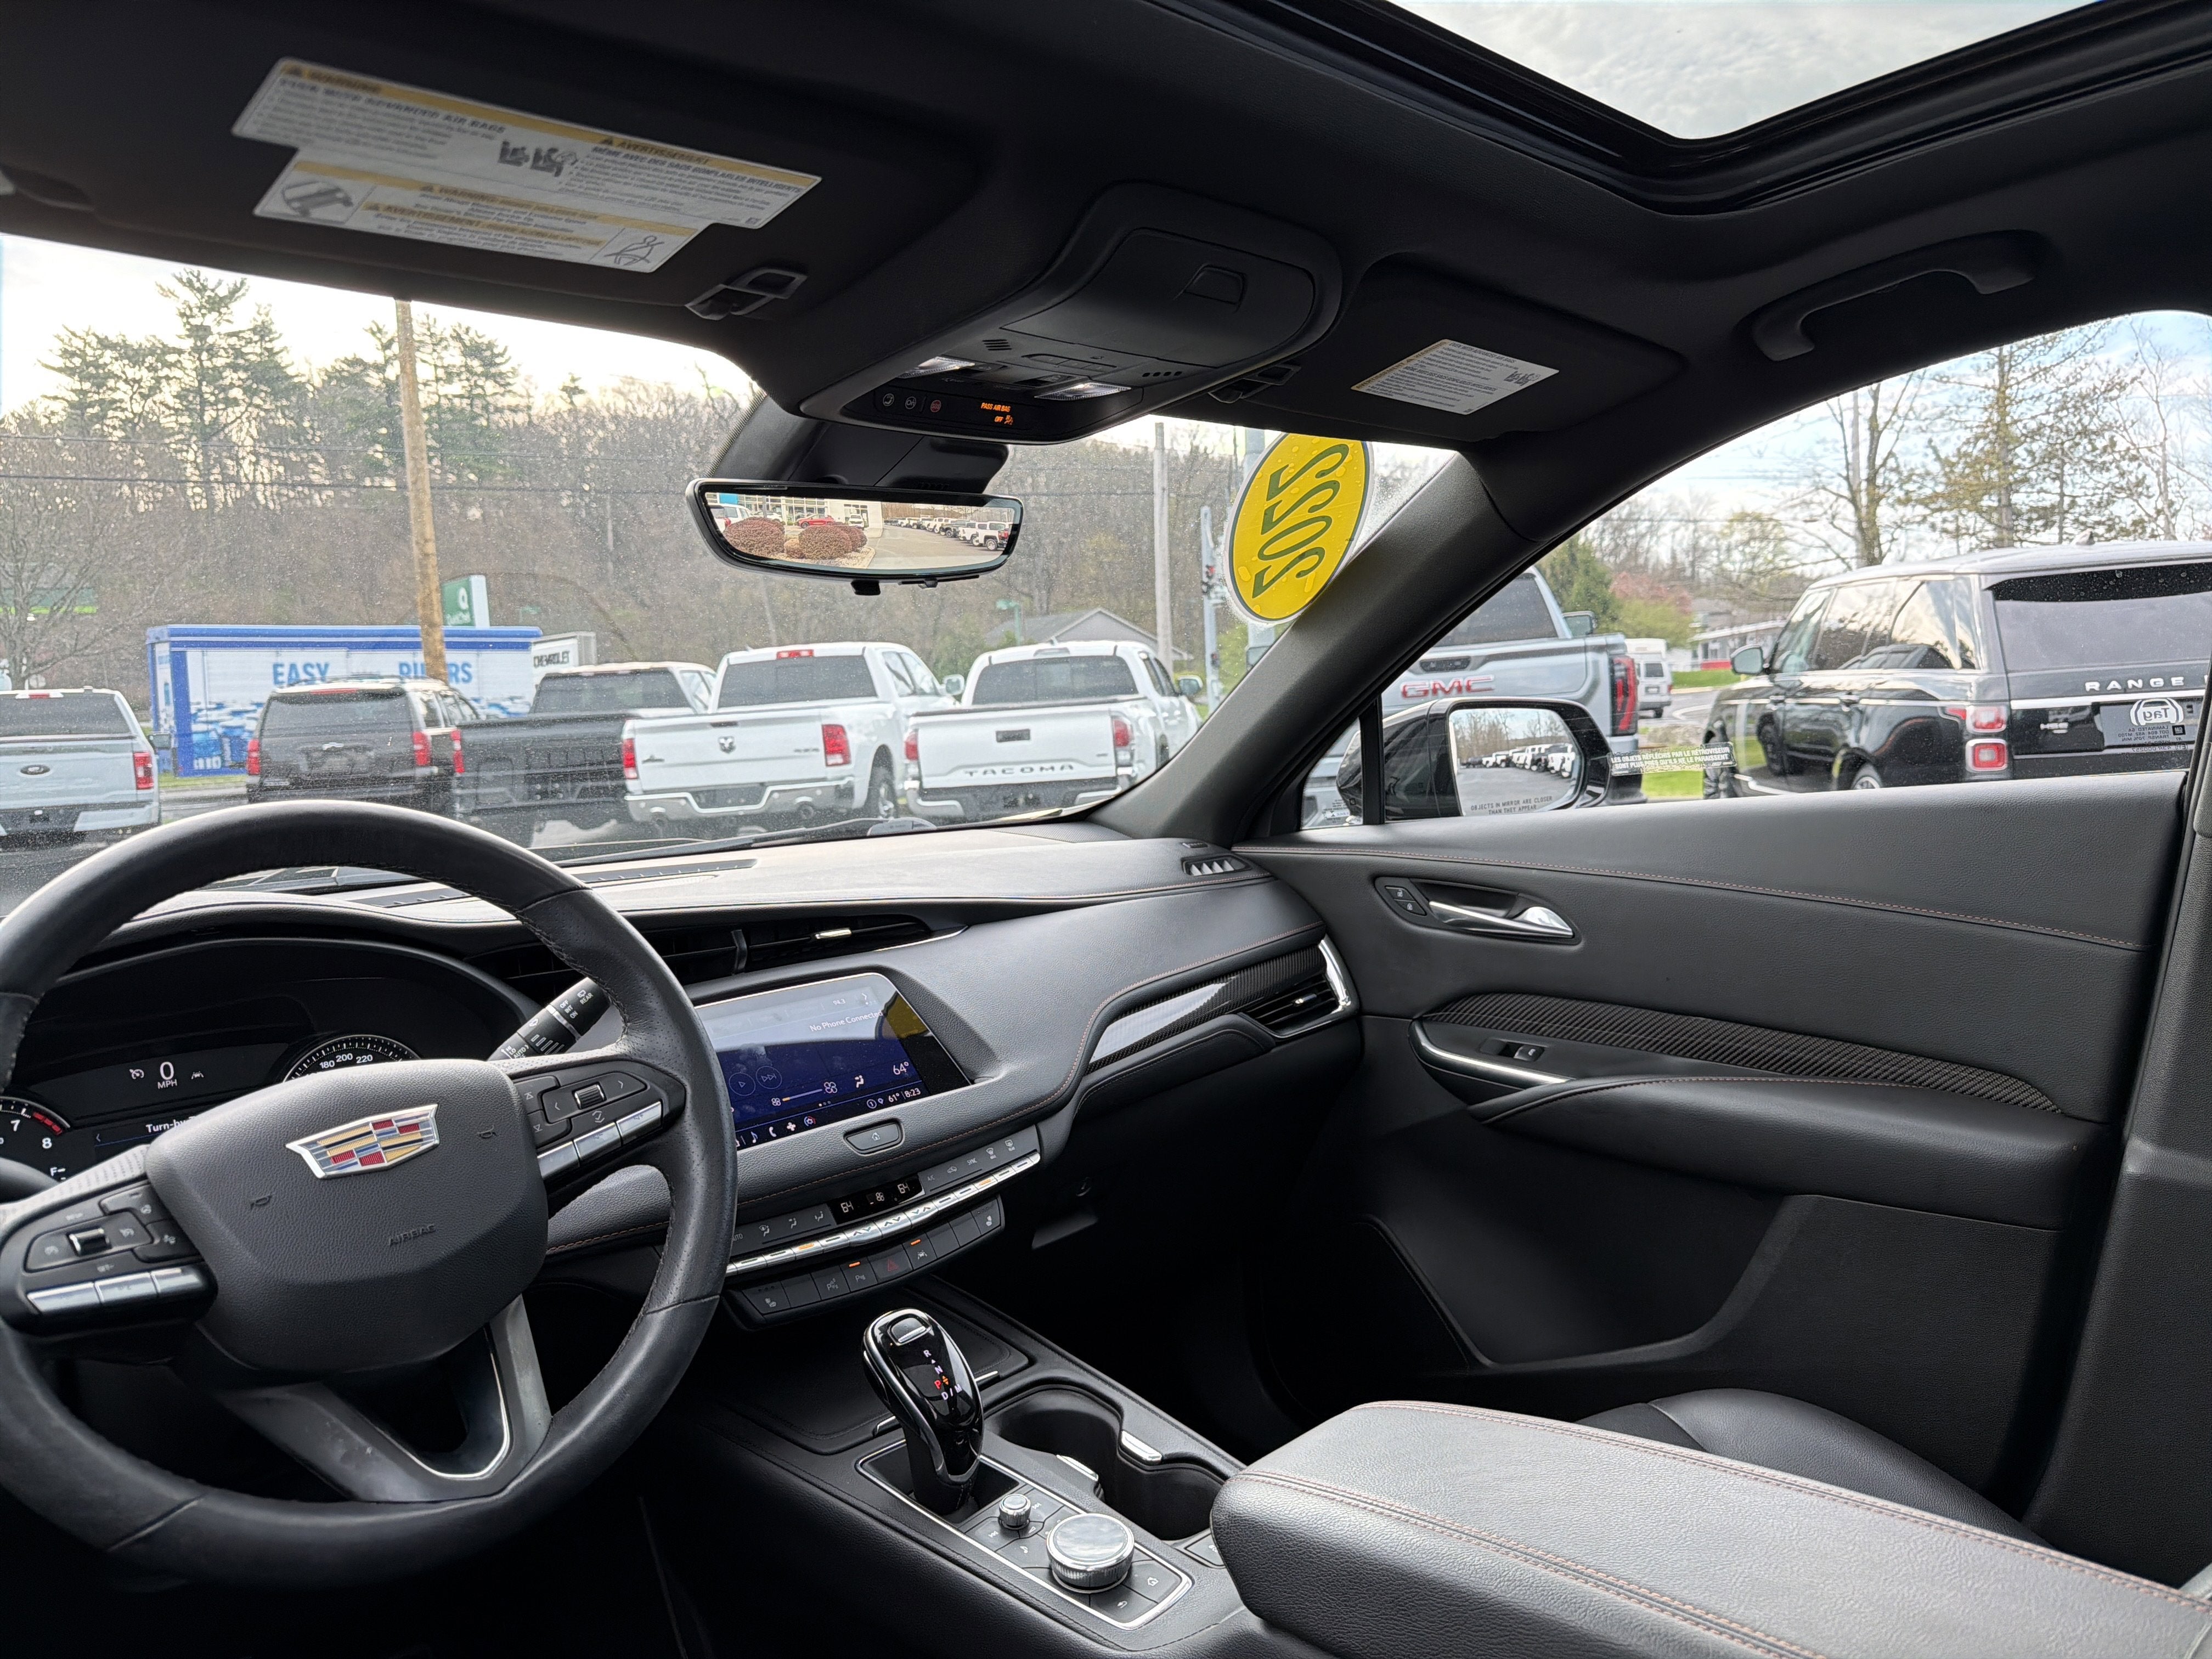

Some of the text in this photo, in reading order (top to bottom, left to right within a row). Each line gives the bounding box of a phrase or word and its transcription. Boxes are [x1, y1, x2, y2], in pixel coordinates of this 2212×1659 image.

[980, 402, 993, 410] PASS
[272, 662, 330, 686] EASY
[1400, 675, 1495, 699] GMC
[2085, 676, 2185, 692] RANGE
[1694, 753, 1728, 763] PARAISSENT
[964, 764, 1075, 778] TACOMA
[1471, 802, 1494, 811] OBJECTS
[1534, 795, 1553, 804] CLOSER
[1518, 804, 1537, 812] APPEAR
[560, 999, 569, 1009] OFF
[579, 992, 594, 1005] REAR
[564, 1004, 573, 1014] INT
[569, 1010, 579, 1019] ON
[809, 1009, 884, 1032] No Phone Connected
[335, 1053, 353, 1063] 200
[513, 1047, 527, 1058] AUTO
[319, 1060, 335, 1069] 180
[356, 1054, 373, 1064] 220
[160, 1062, 174, 1080] 0
[157, 1078, 178, 1090] MPH
[904, 1087, 921, 1099] 8:23
[10, 1119, 21, 1132] 7
[42, 1137, 53, 1149] 8
[966, 1157, 978, 1166] SYNC
[50, 1166, 58, 1177] F
[897, 1182, 910, 1194] 64
[840, 1200, 854, 1213] 64
[386, 1223, 437, 1248] AIRBAG
[923, 1349, 932, 1358] R
[934, 1365, 943, 1375] N
[934, 1380, 942, 1390] P
